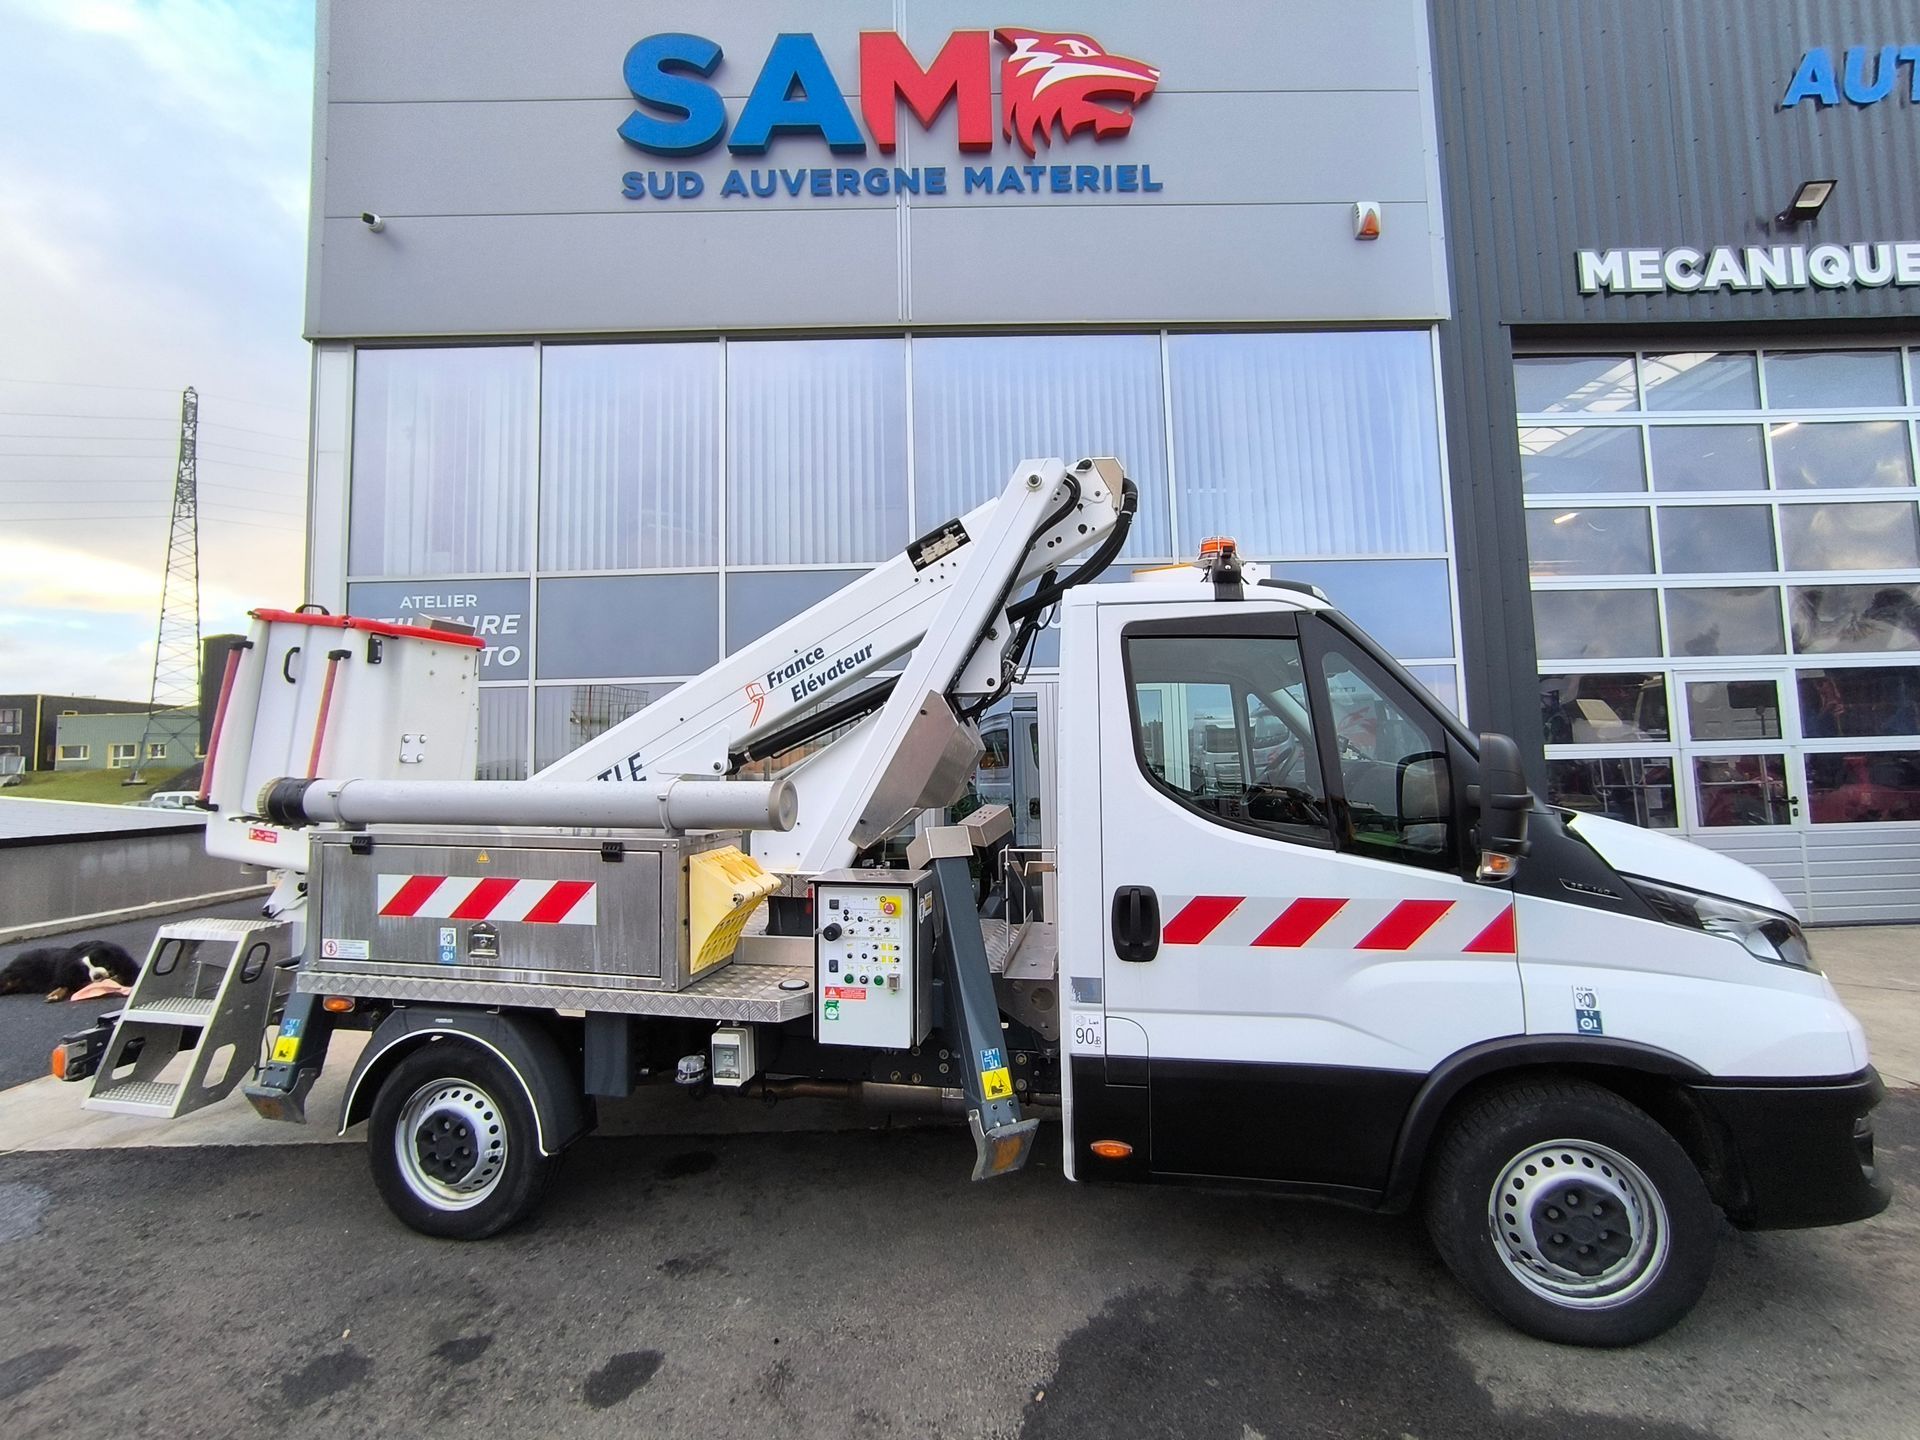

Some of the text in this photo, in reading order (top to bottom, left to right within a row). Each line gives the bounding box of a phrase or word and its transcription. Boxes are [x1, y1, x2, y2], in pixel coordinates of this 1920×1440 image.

[617, 30, 992, 155] SAM
[621, 165, 1163, 199] SUD AUVERGNE MATERIEL
[1578, 242, 1920, 292] MECANIQUE
[400, 594, 477, 609] ATELIER
[767, 647, 825, 689] France
[791, 644, 874, 702] Elévateur
[1075, 1028, 1094, 1044] 90
